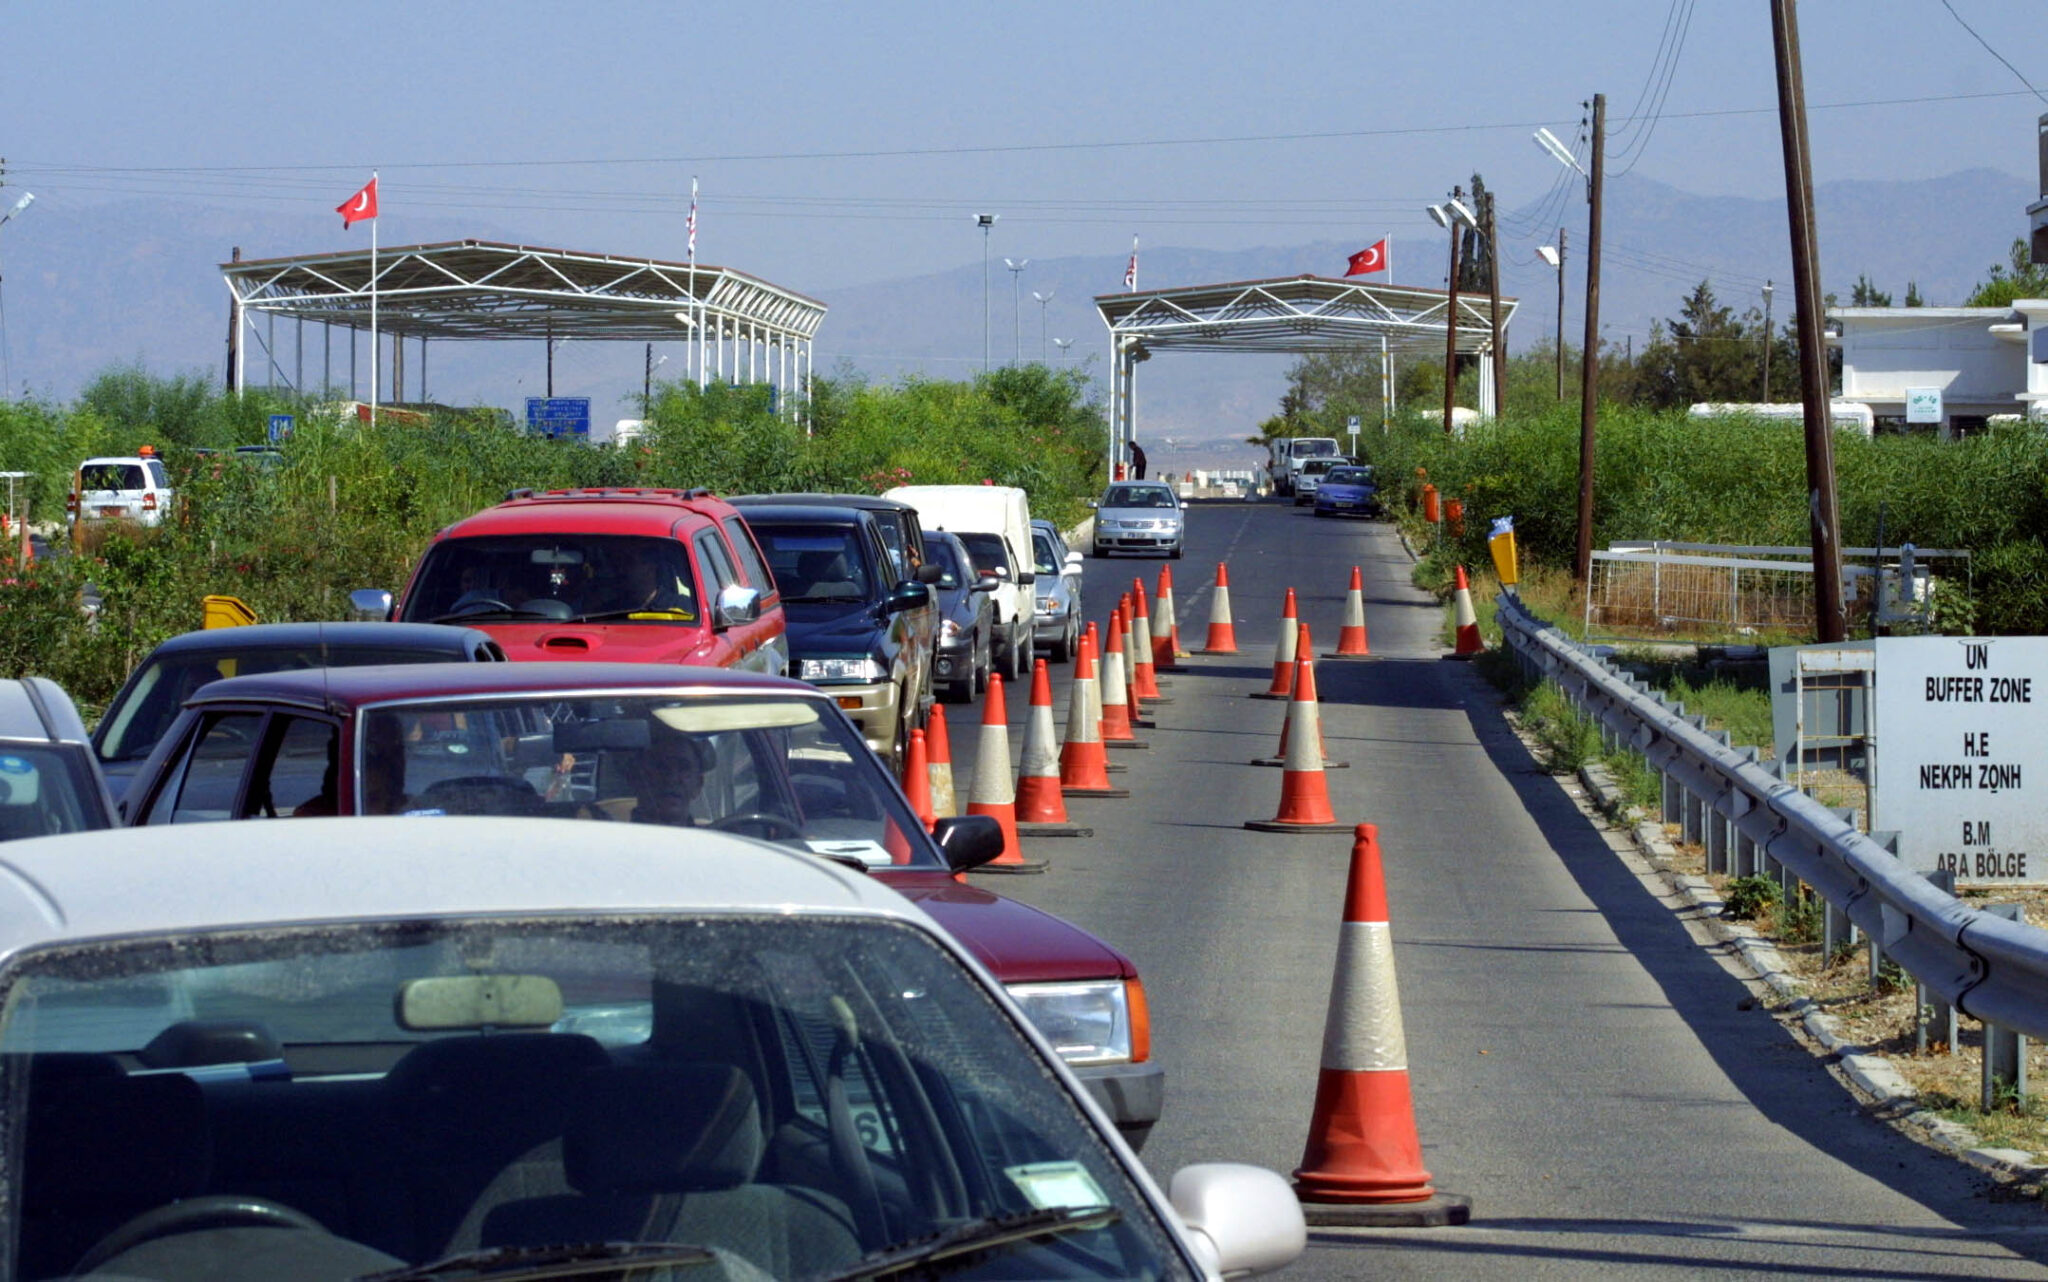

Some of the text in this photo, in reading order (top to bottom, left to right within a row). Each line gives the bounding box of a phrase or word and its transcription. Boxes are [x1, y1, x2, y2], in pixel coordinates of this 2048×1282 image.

[1966, 645, 1988, 670] UN
[1925, 676, 2032, 703] BUFFER ZONE
[1962, 820, 1991, 846] B.M
[1937, 848, 2027, 878] ARA BÖLGE
